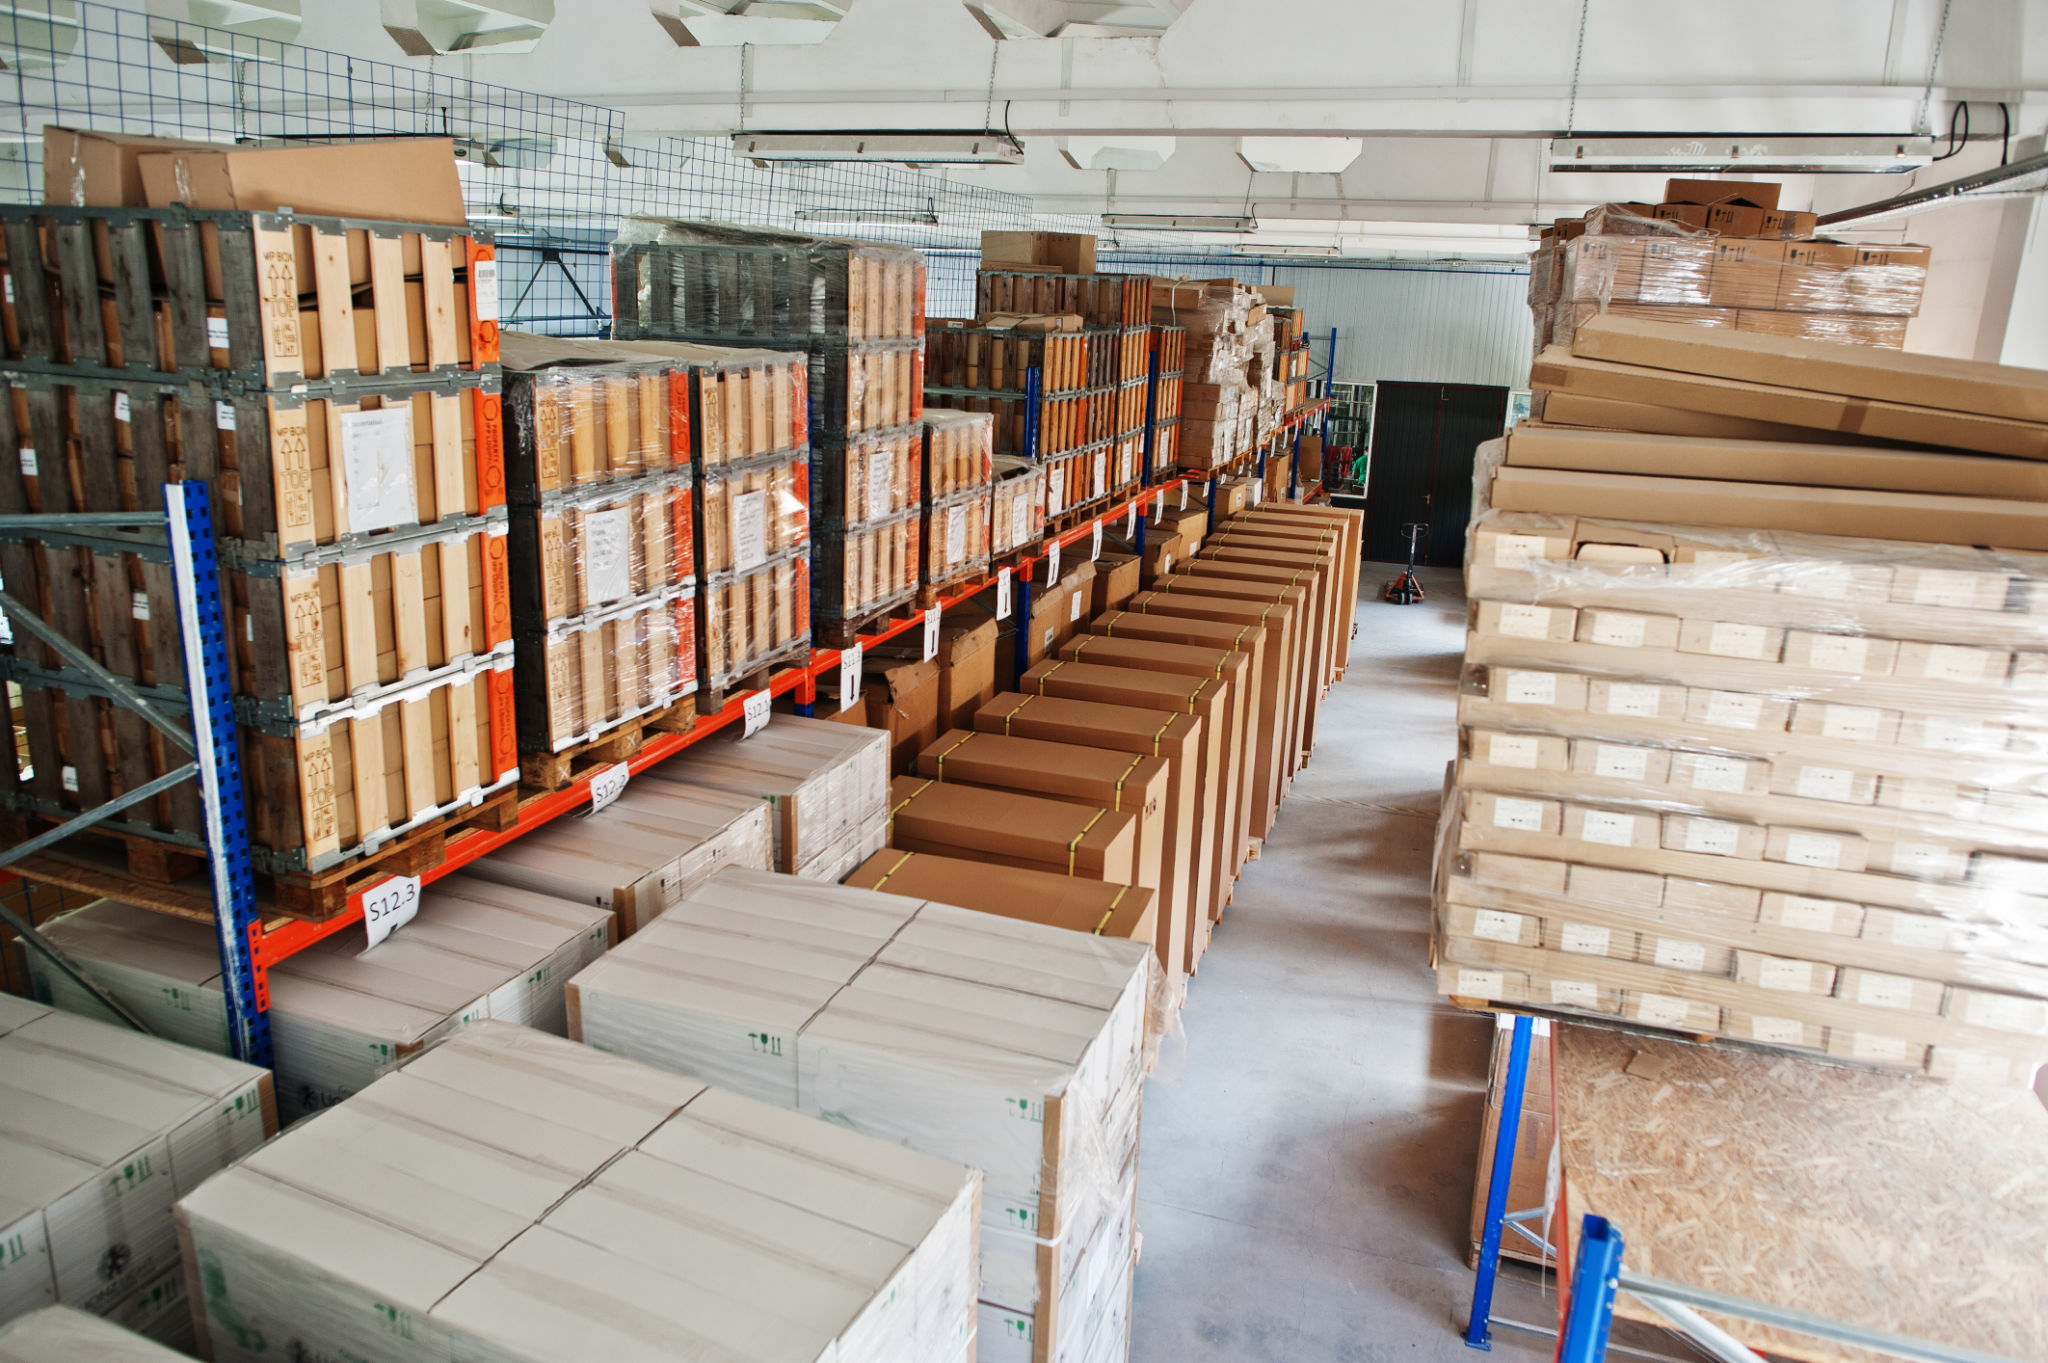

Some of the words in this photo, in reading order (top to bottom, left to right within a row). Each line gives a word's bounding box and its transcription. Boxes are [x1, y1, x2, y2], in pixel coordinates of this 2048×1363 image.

[267, 297, 297, 318] TOP
[280, 470, 309, 490] TOP
[295, 630, 323, 651] TOP
[596, 774, 626, 803] S12.2
[370, 884, 415, 922] S12.3
